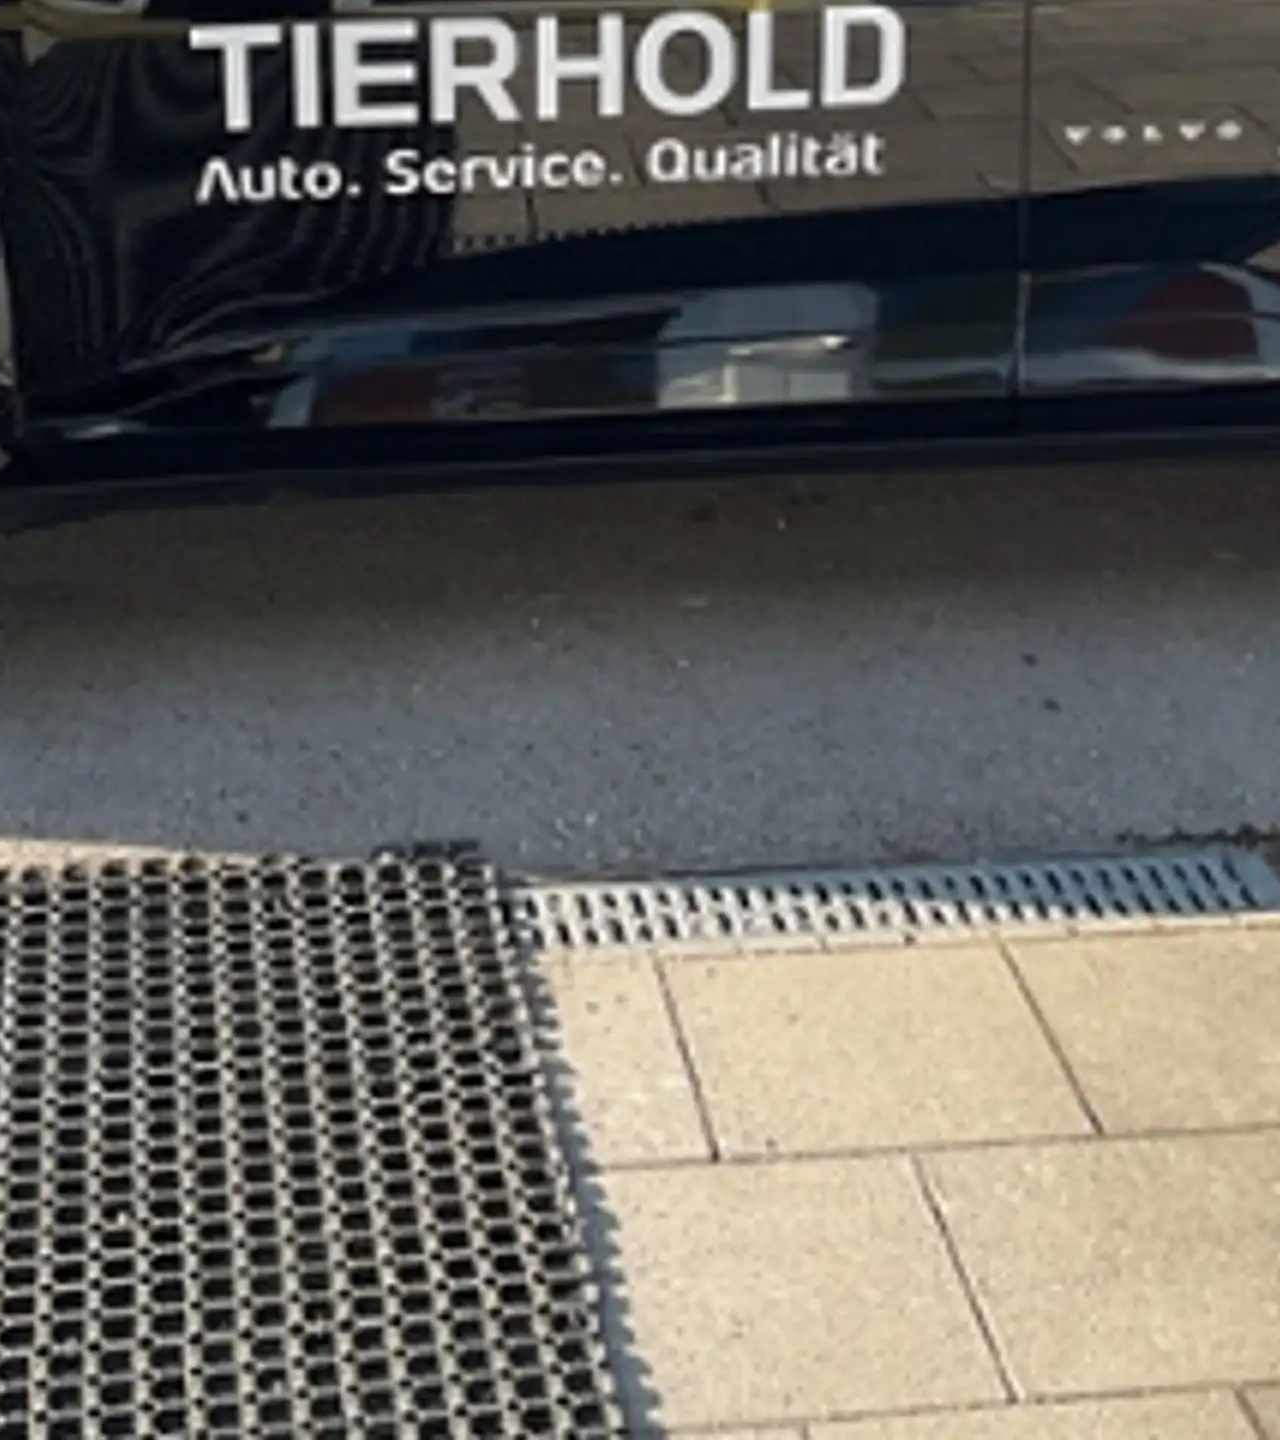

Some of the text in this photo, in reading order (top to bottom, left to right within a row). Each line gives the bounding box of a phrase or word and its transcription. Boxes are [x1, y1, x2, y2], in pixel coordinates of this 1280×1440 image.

[189, 4, 906, 133] TIERHOLD
[195, 131, 885, 205] Auto. Service. Qualität
